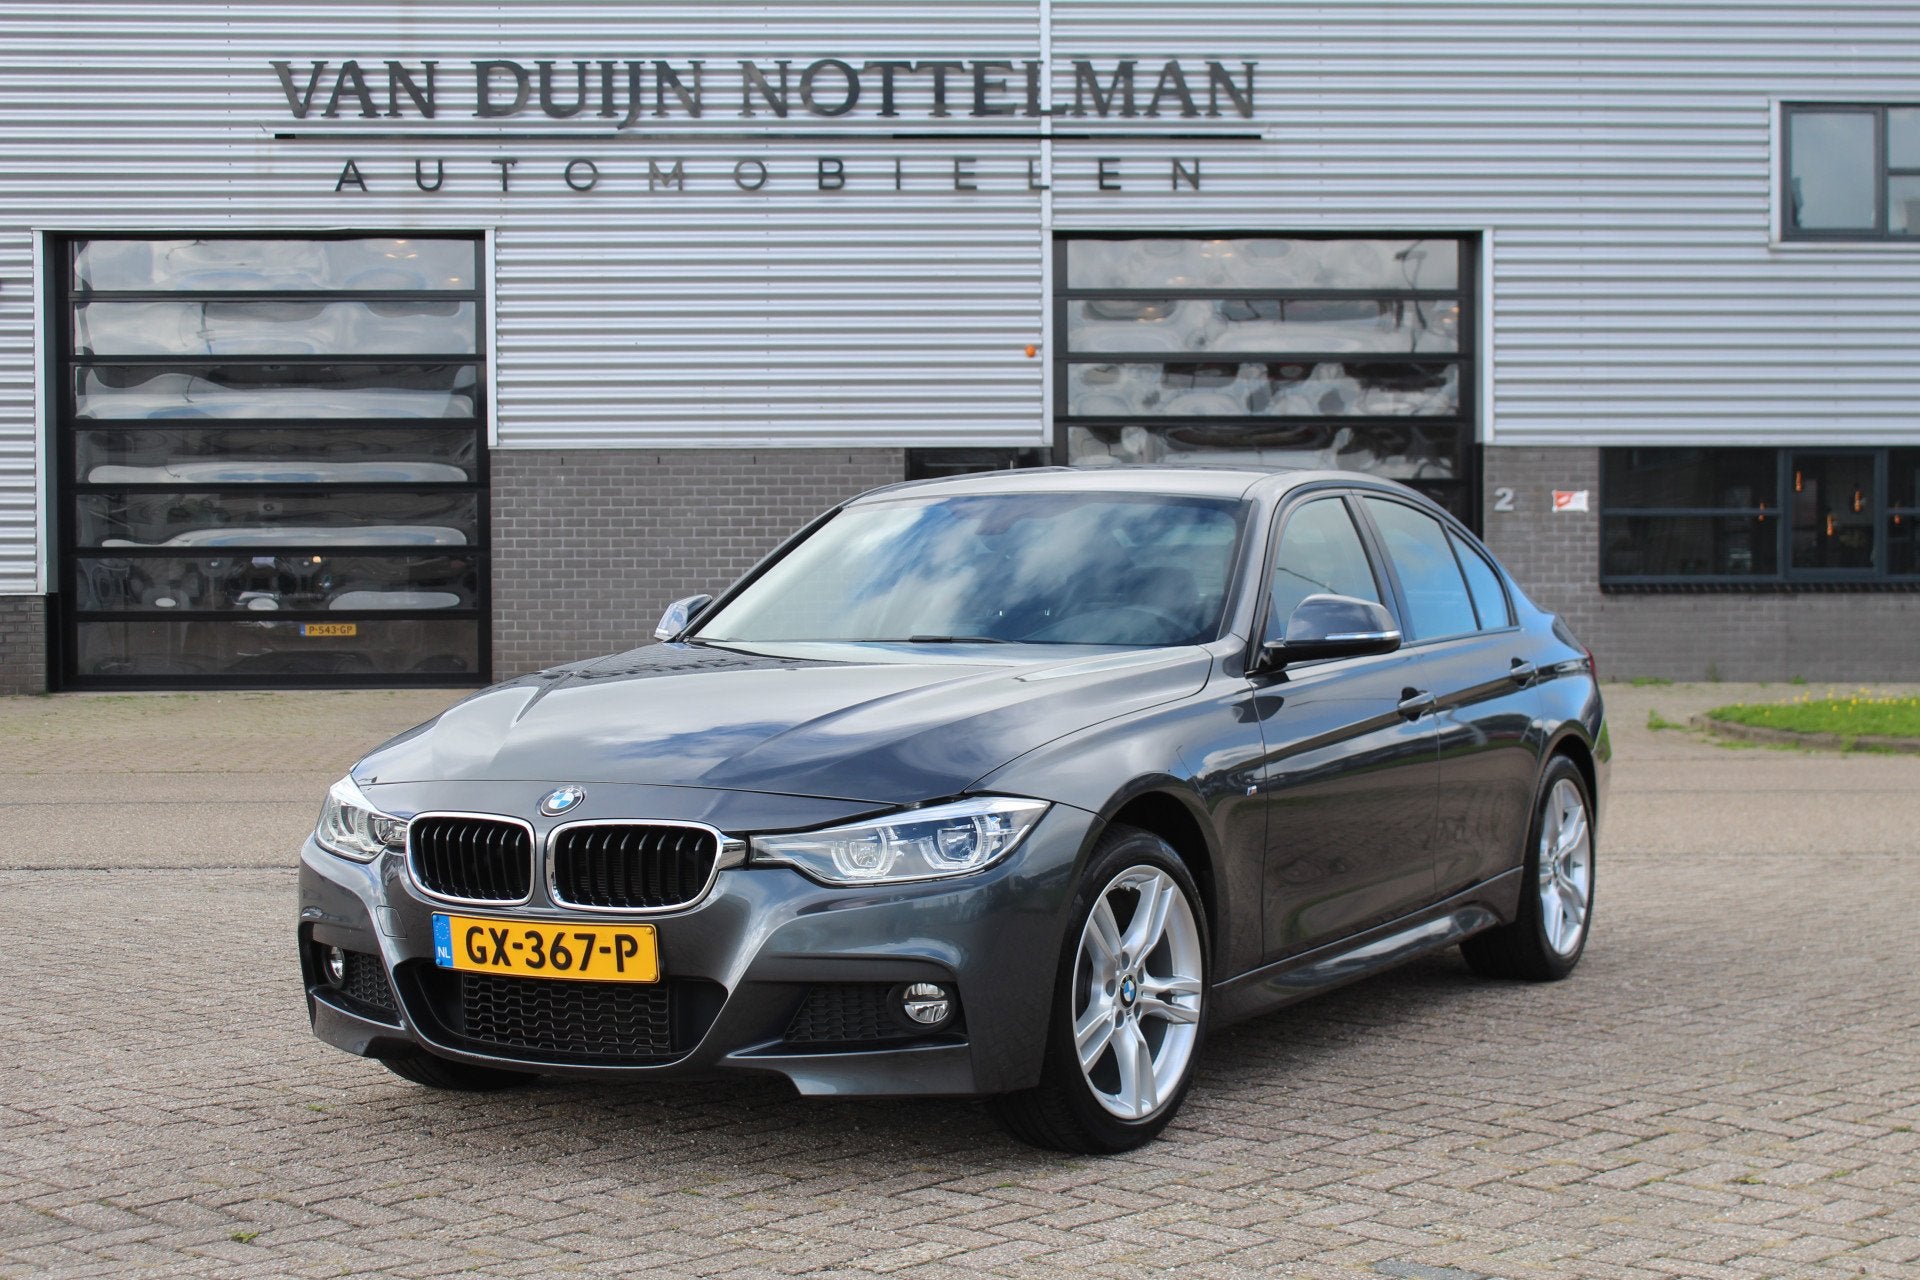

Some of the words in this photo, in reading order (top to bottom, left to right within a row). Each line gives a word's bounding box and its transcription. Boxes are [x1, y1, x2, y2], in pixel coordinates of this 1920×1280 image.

[269, 60, 439, 118] VAN
[470, 60, 705, 130] DUIJN
[737, 59, 1258, 118] NOTTELMAN
[335, 158, 1199, 191] AUTOMOBIELEN
[1494, 487, 1514, 511] 2
[437, 946, 451, 959] NL
[465, 926, 638, 972] GX-367-P
